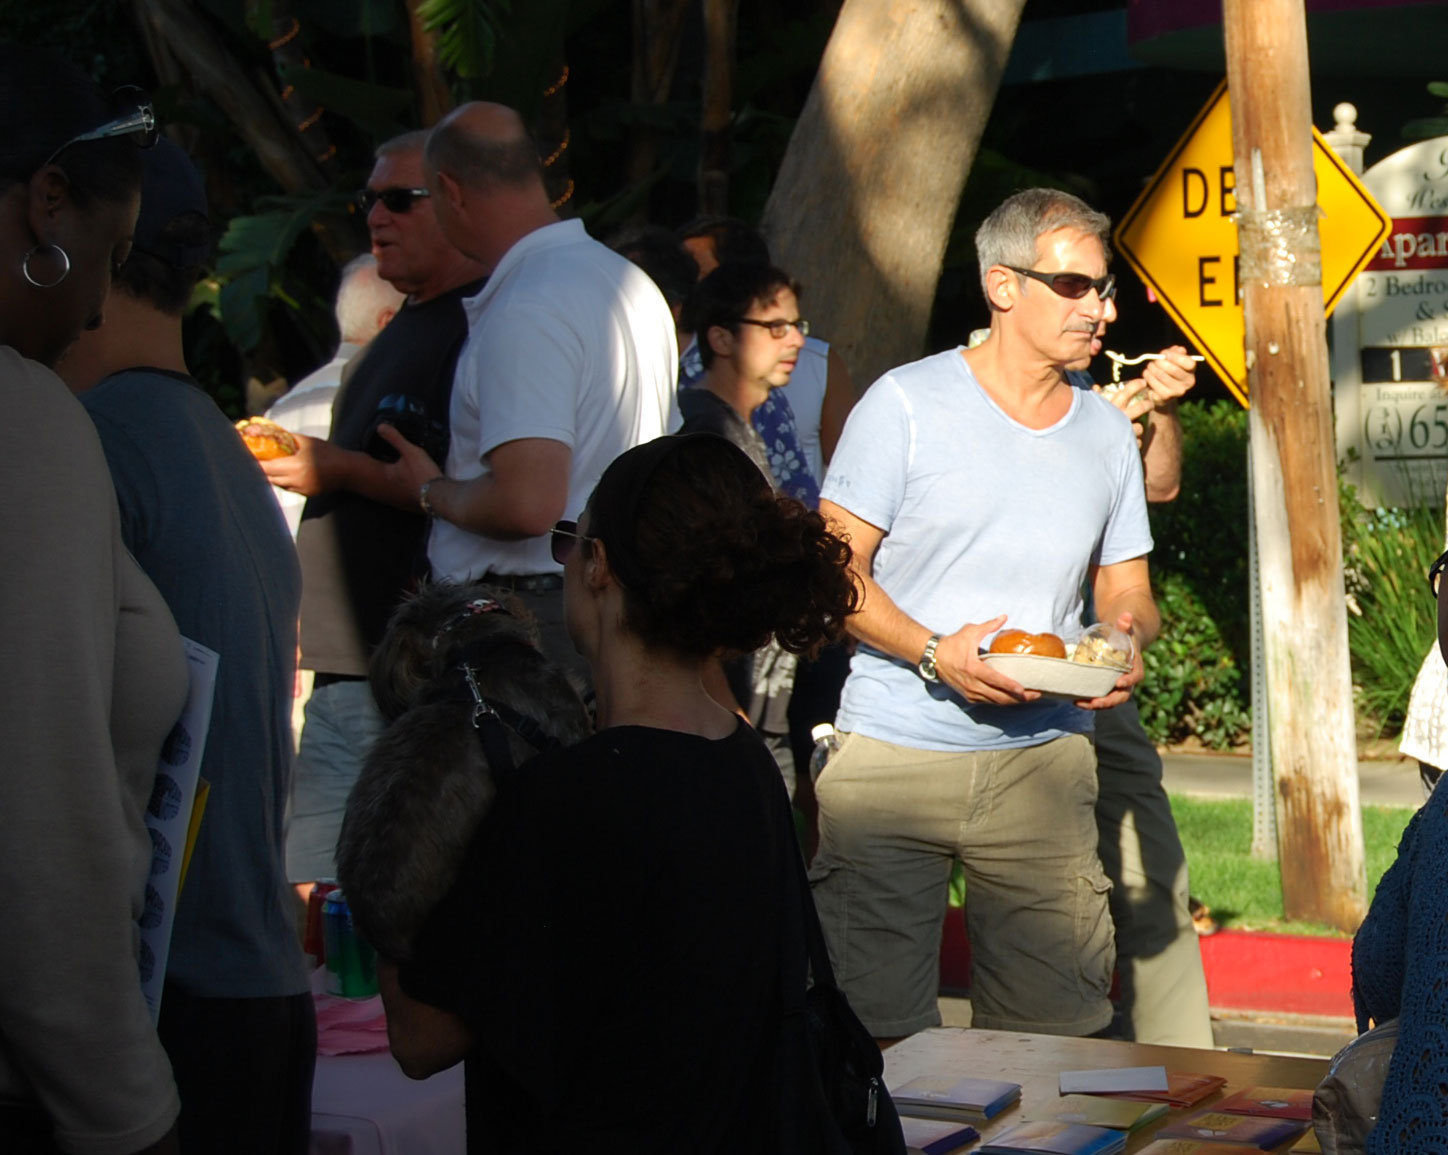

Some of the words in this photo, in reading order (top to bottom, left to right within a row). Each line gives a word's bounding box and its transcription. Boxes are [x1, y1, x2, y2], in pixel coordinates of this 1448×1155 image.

[1183, 166, 1237, 218] DE
[1367, 277, 1377, 297] 2
[1416, 301, 1435, 321] &
[1376, 387, 1425, 403] Inquire
